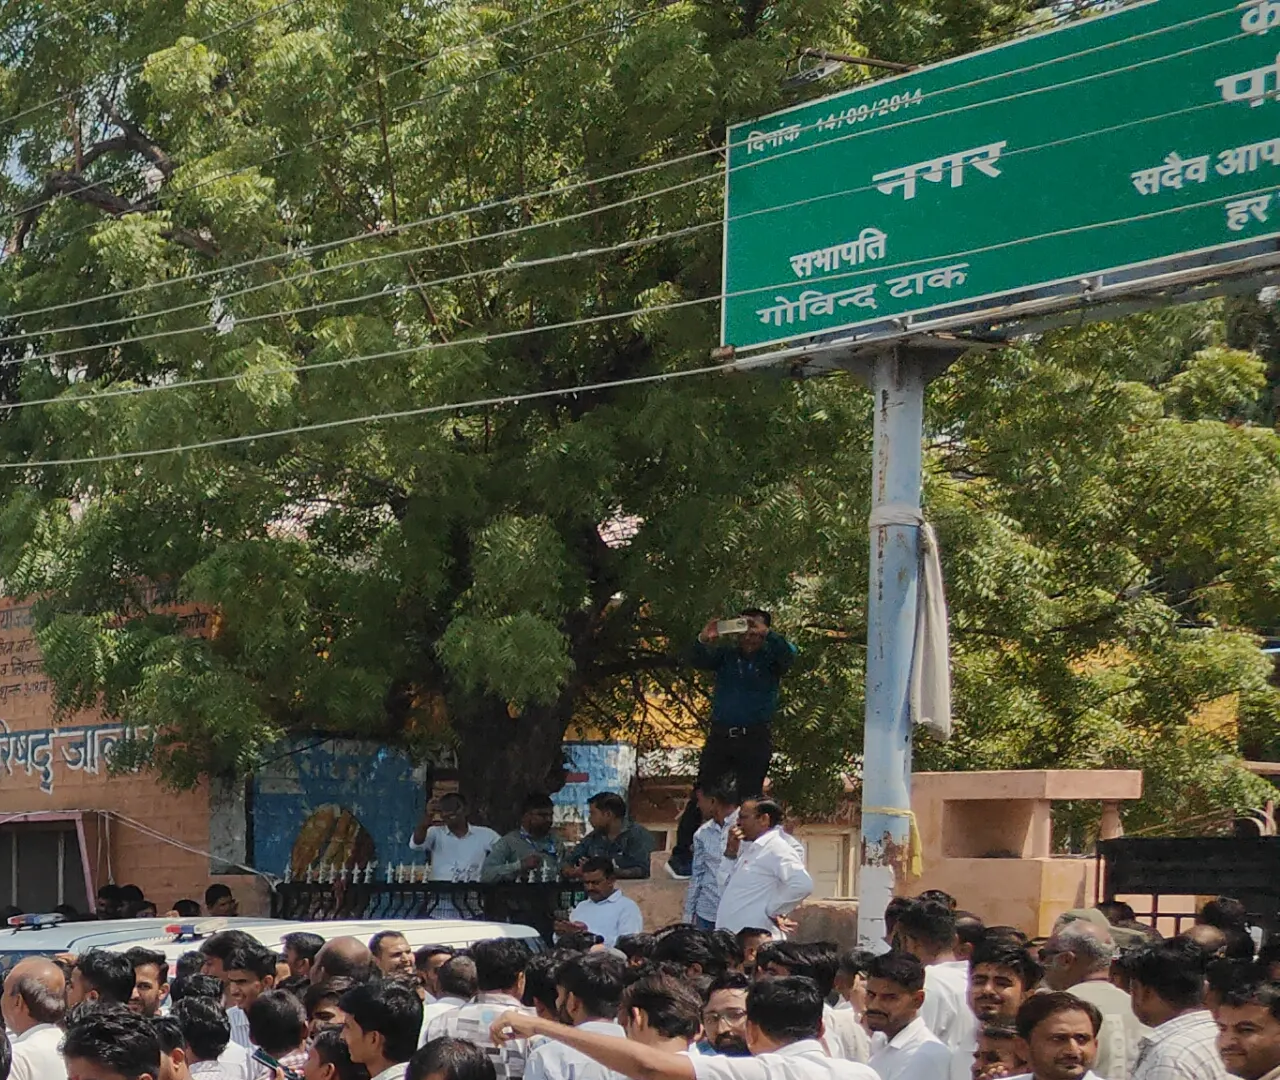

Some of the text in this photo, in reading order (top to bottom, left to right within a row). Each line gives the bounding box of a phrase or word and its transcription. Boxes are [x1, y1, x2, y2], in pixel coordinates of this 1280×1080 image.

[747, 88, 923, 154] दिनांक 14/09/2014
[872, 140, 1007, 200] नगर
[1131, 152, 1209, 195] सदैव
[1225, 194, 1272, 231] हर
[789, 227, 887, 278] सभापति
[756, 263, 970, 327] गोविन्द टाक
